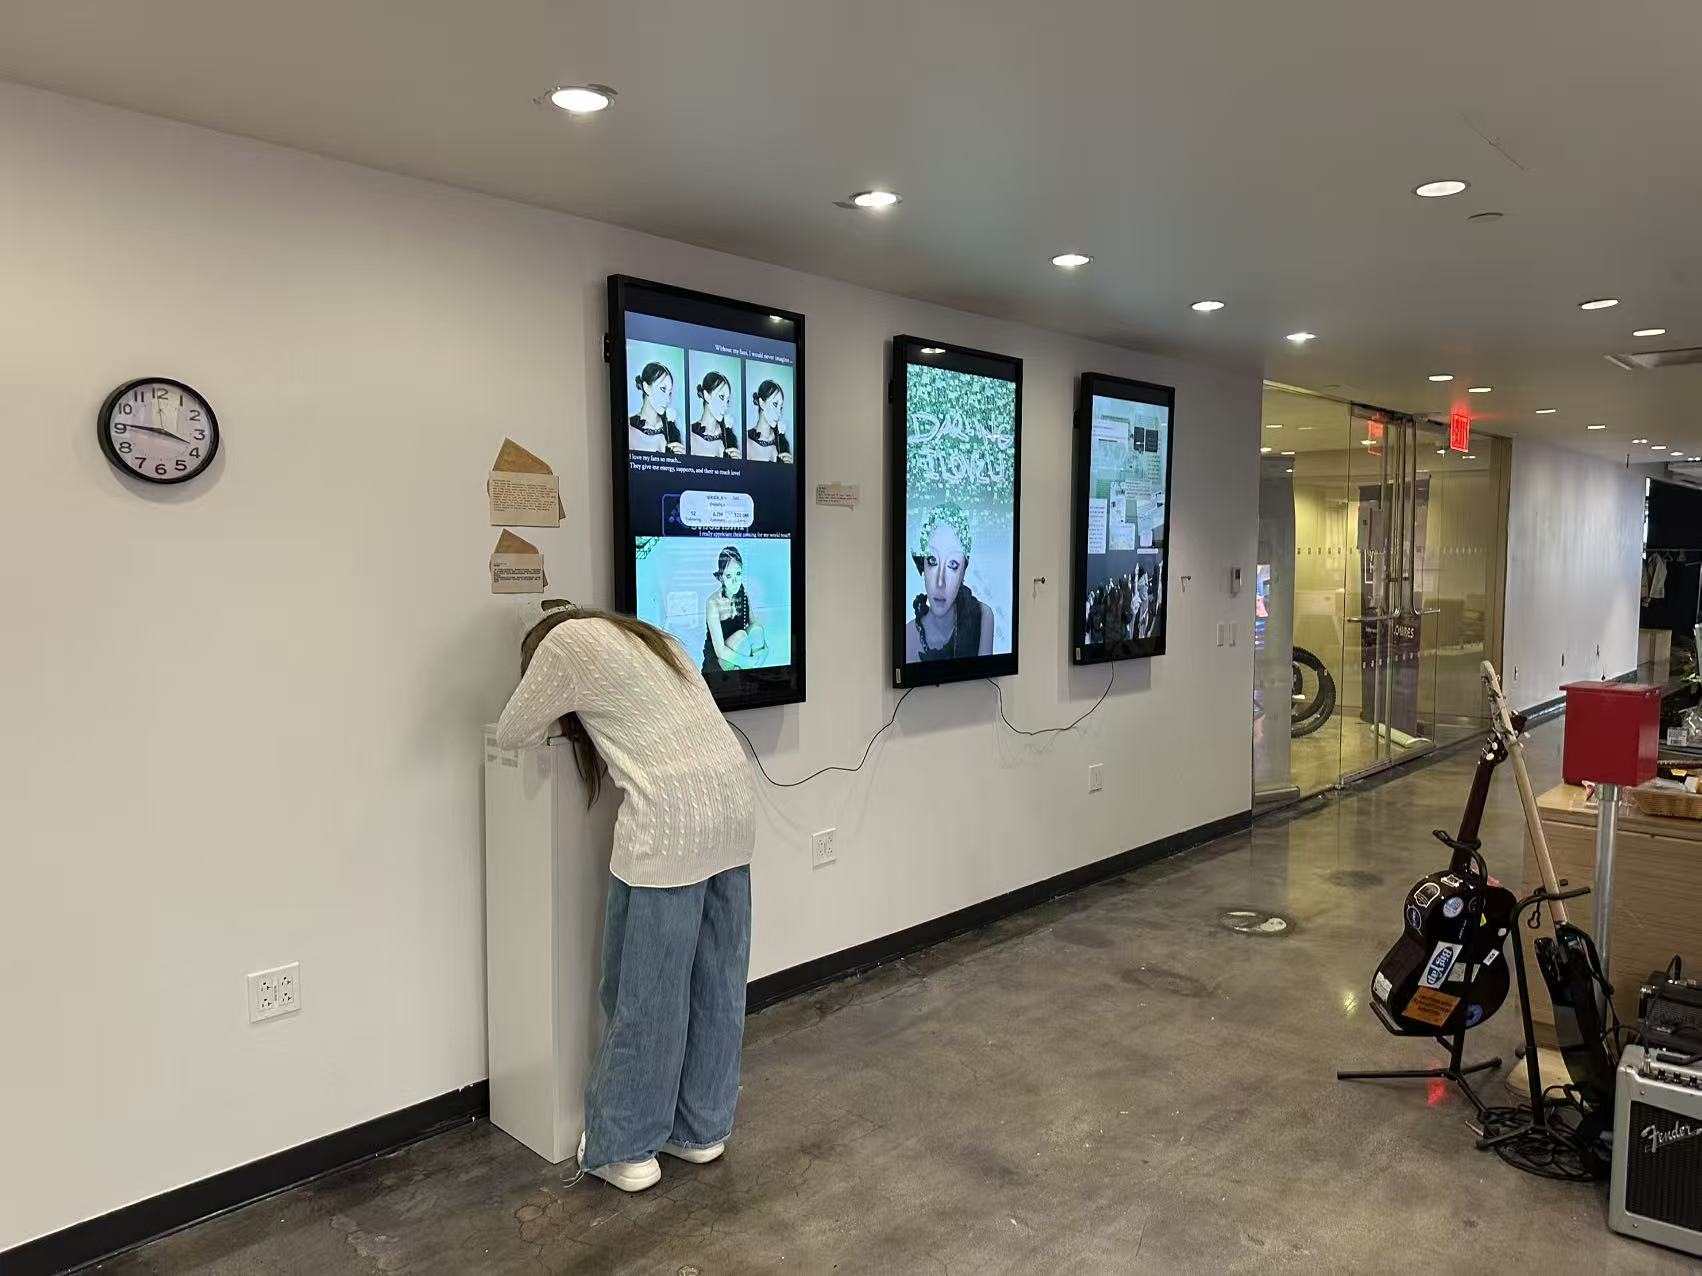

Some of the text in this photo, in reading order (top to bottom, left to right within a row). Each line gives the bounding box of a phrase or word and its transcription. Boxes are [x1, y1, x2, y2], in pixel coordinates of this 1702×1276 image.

[134, 390, 145, 402] 11
[152, 387, 169, 400] 12
[119, 403, 133, 415] 10
[189, 409, 201, 421] 2
[114, 422, 127, 434] 9
[193, 429, 206, 441] 3
[118, 441, 132, 454] 8
[189, 447, 200, 459] 4
[135, 456, 147, 469] 7
[650, 454, 660, 462] fans
[154, 463, 167, 475] 6
[175, 460, 188, 472] 5
[629, 462, 641, 470] They
[641, 463, 651, 471] give
[1640, 1120, 1692, 1154] Fender
